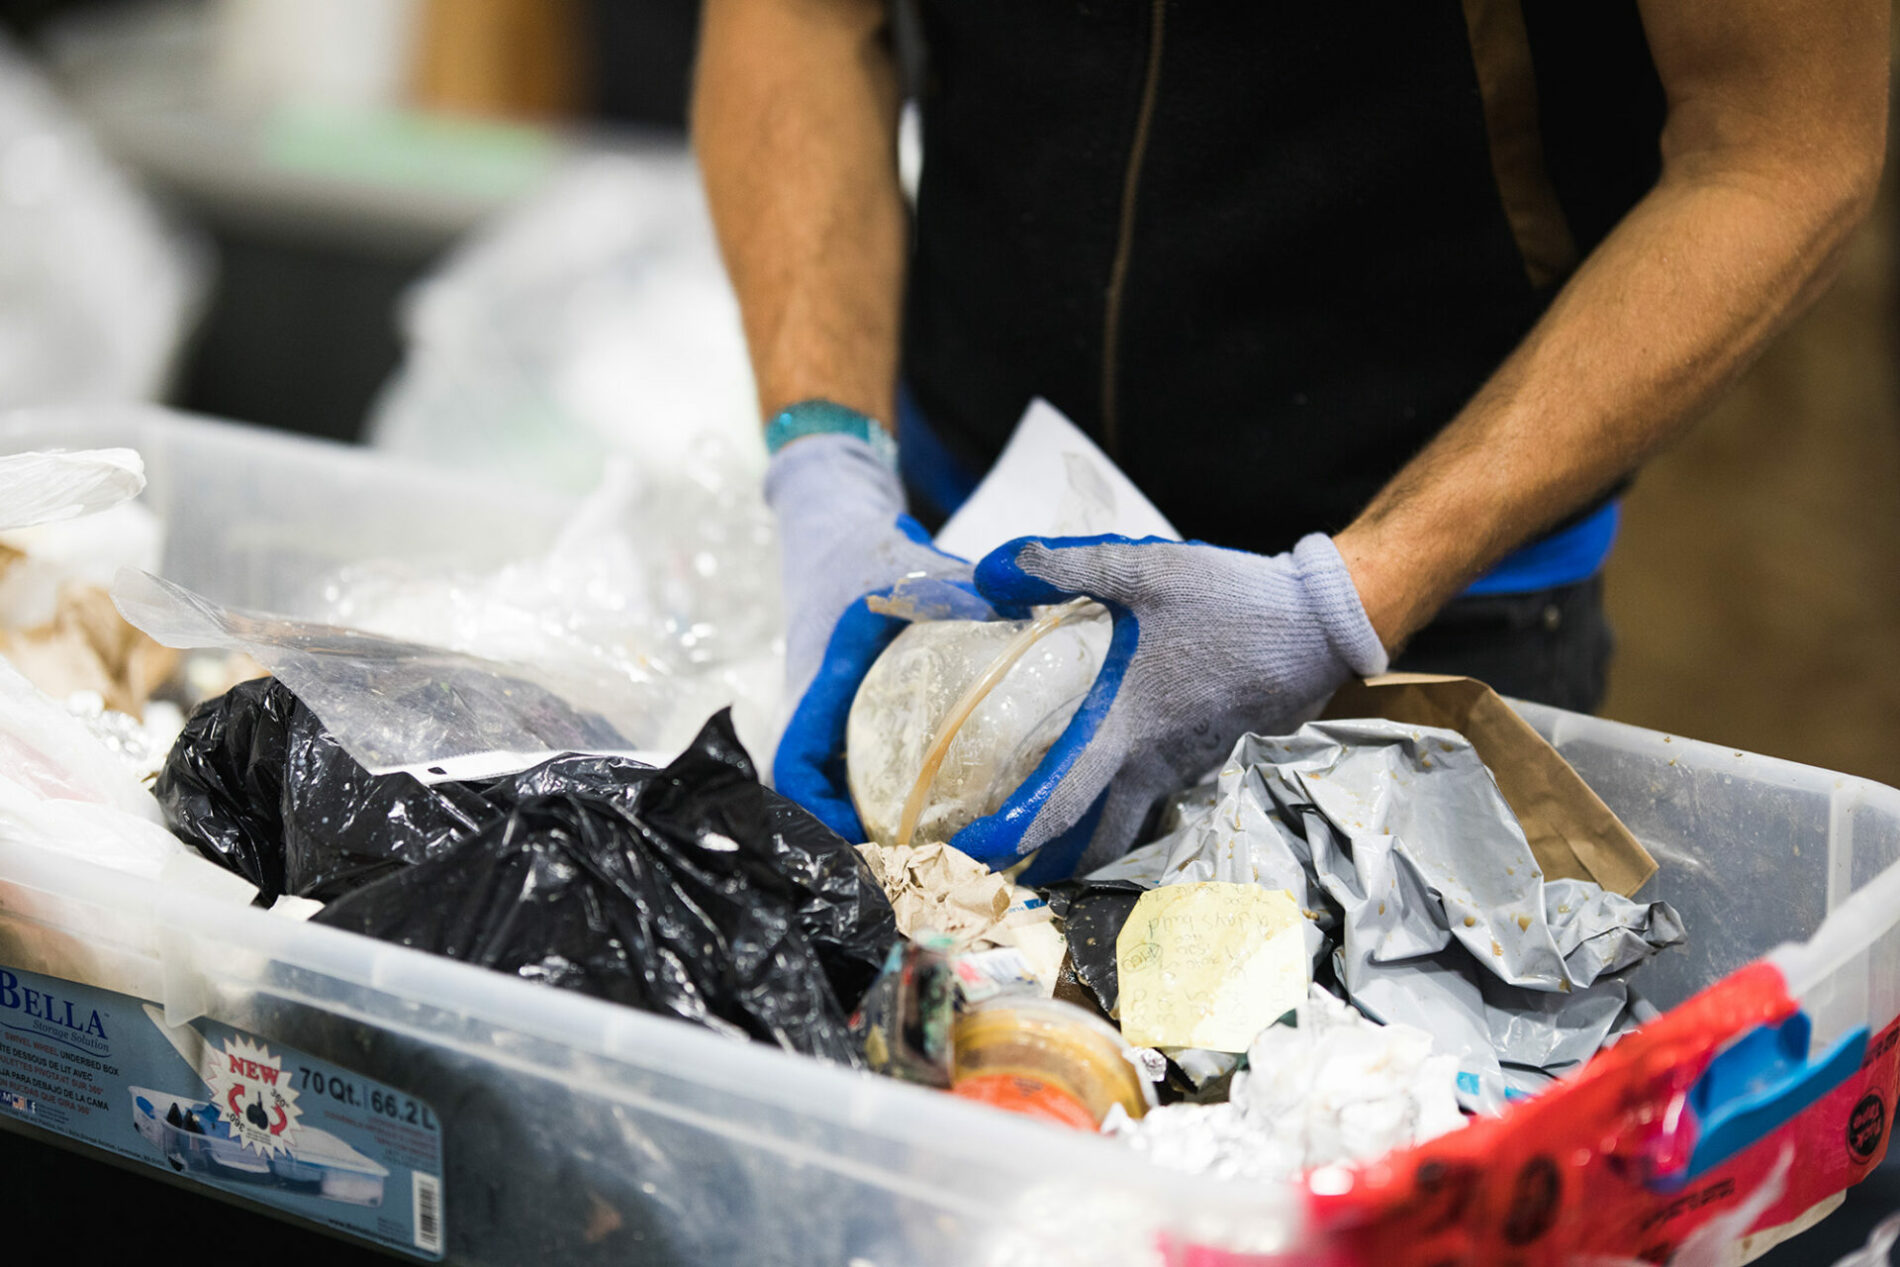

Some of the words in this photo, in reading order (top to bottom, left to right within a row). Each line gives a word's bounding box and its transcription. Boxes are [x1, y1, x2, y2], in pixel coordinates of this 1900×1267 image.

[0, 969, 108, 1040] BELLA
[33, 1019, 69, 1040] Storage
[70, 1031, 110, 1053] Solution
[48, 1060, 59, 1071] DE
[73, 1069, 93, 1082] AVEC
[60, 1050, 101, 1071] UNDERBED
[228, 1053, 280, 1087] NEW
[12, 1071, 31, 1085] PARA
[32, 1078, 62, 1095] DEBAJO
[64, 1088, 73, 1099] DE
[75, 1092, 85, 1102] LA
[87, 1096, 109, 1111] CAMA
[299, 1066, 325, 1095] 70
[328, 1076, 361, 1108] Qt.
